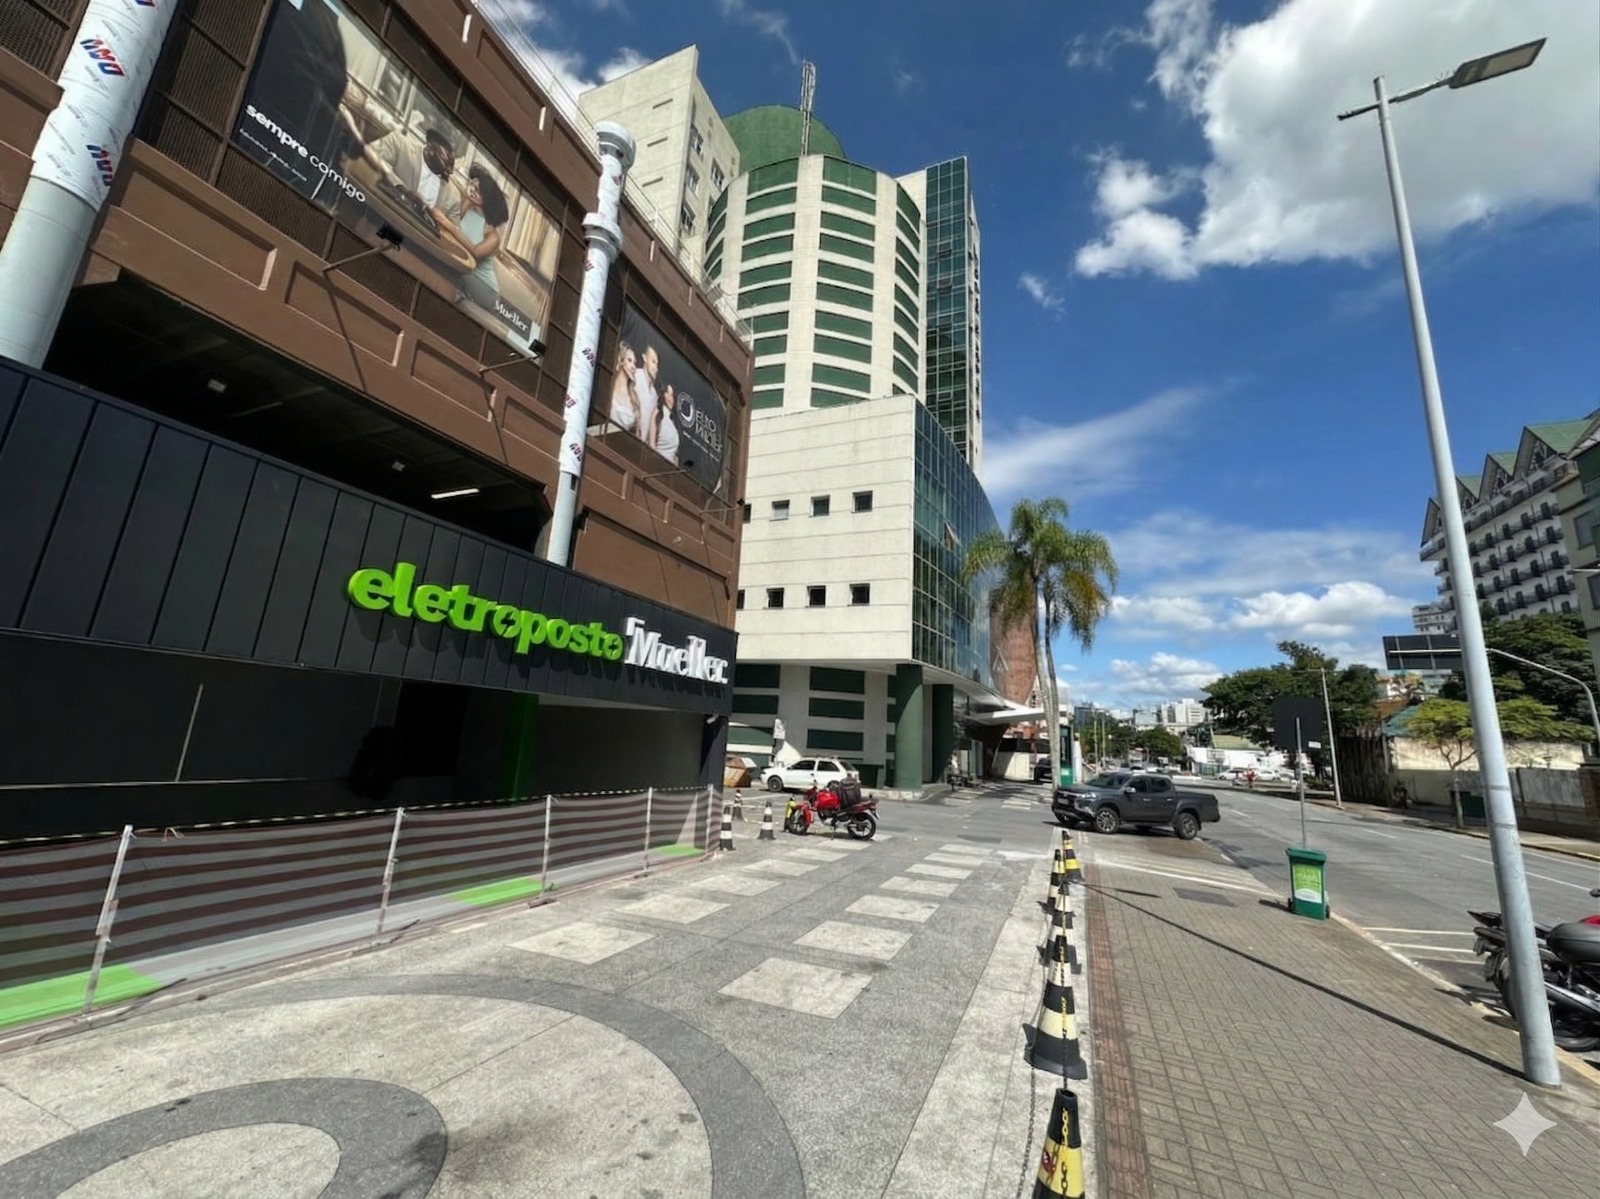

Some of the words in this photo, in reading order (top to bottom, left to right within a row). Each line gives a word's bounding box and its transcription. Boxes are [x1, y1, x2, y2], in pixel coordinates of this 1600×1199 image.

[245, 104, 309, 158] sempre
[309, 155, 366, 203] comigo
[493, 299, 529, 332] Mueller
[347, 562, 624, 661] eletroposto
[624, 616, 729, 685] Mueller
